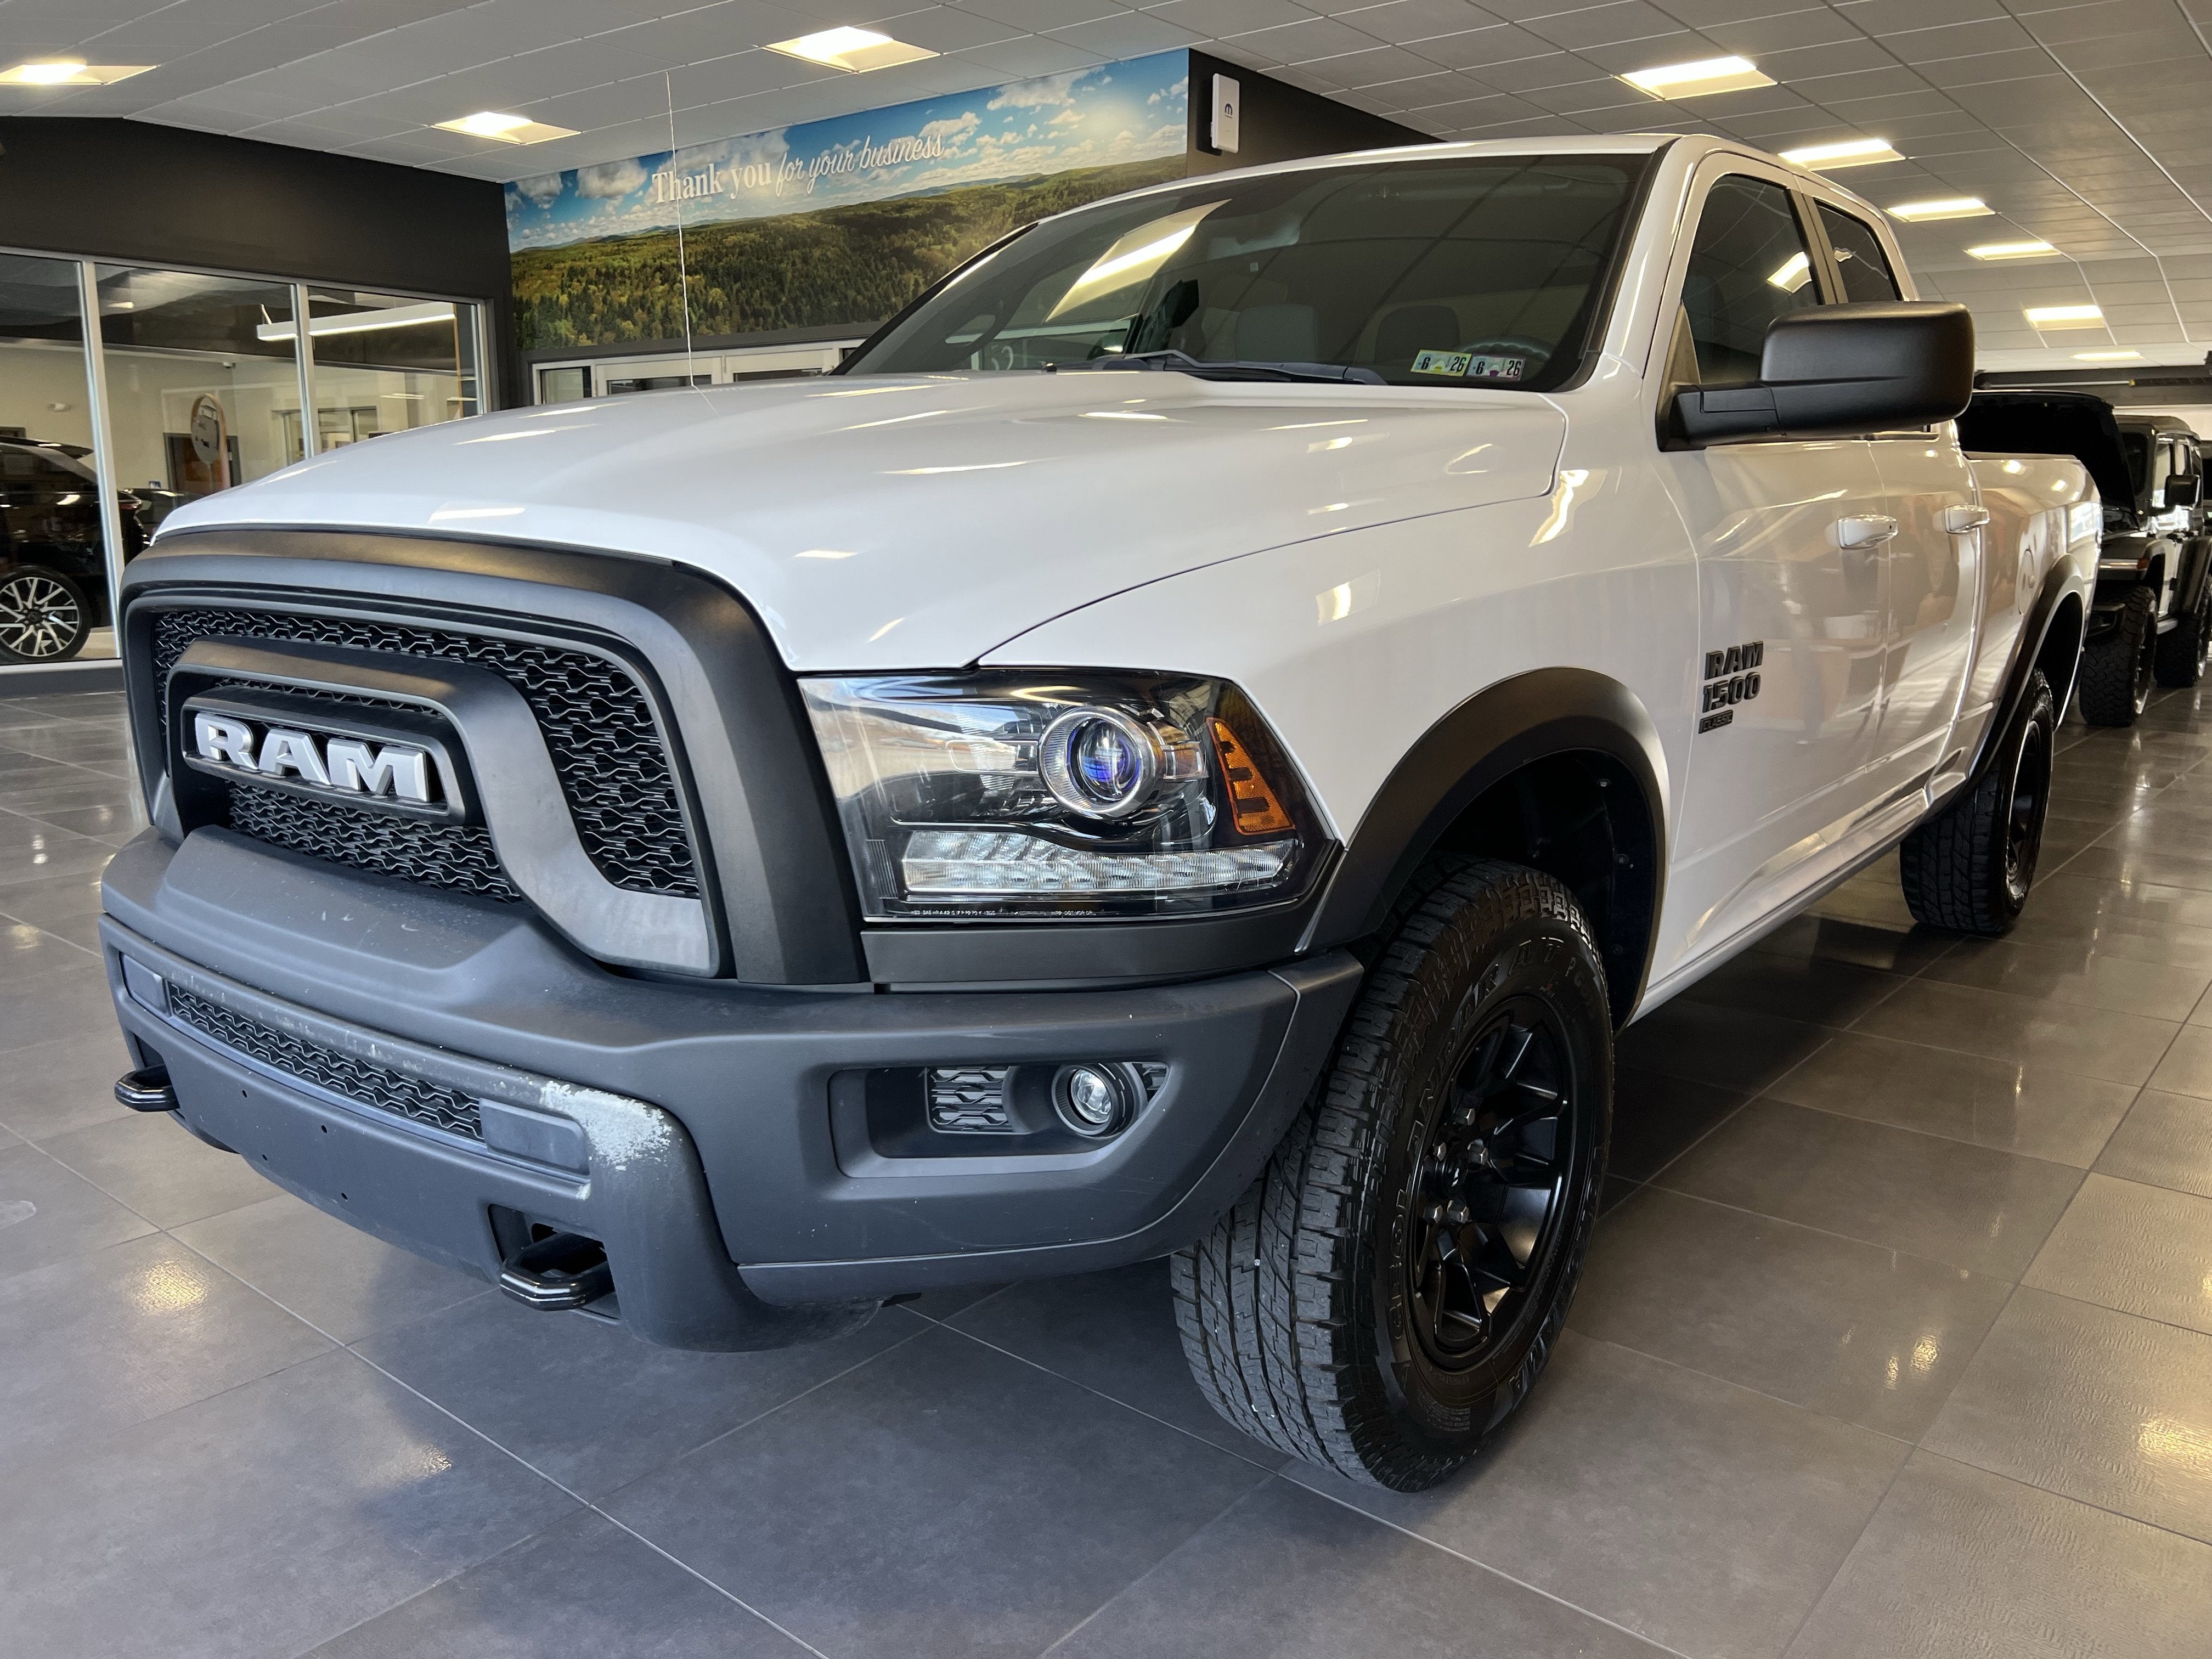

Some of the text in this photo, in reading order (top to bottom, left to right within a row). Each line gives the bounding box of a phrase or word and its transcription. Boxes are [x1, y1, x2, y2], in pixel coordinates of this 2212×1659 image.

[652, 134, 945, 204] Thank you for your business
[1421, 356, 1467, 373] 6 26
[1476, 360, 1522, 376] 6 26
[1705, 641, 1764, 680] RAM
[1702, 672, 1761, 713] 1500
[195, 713, 431, 803] RAM
